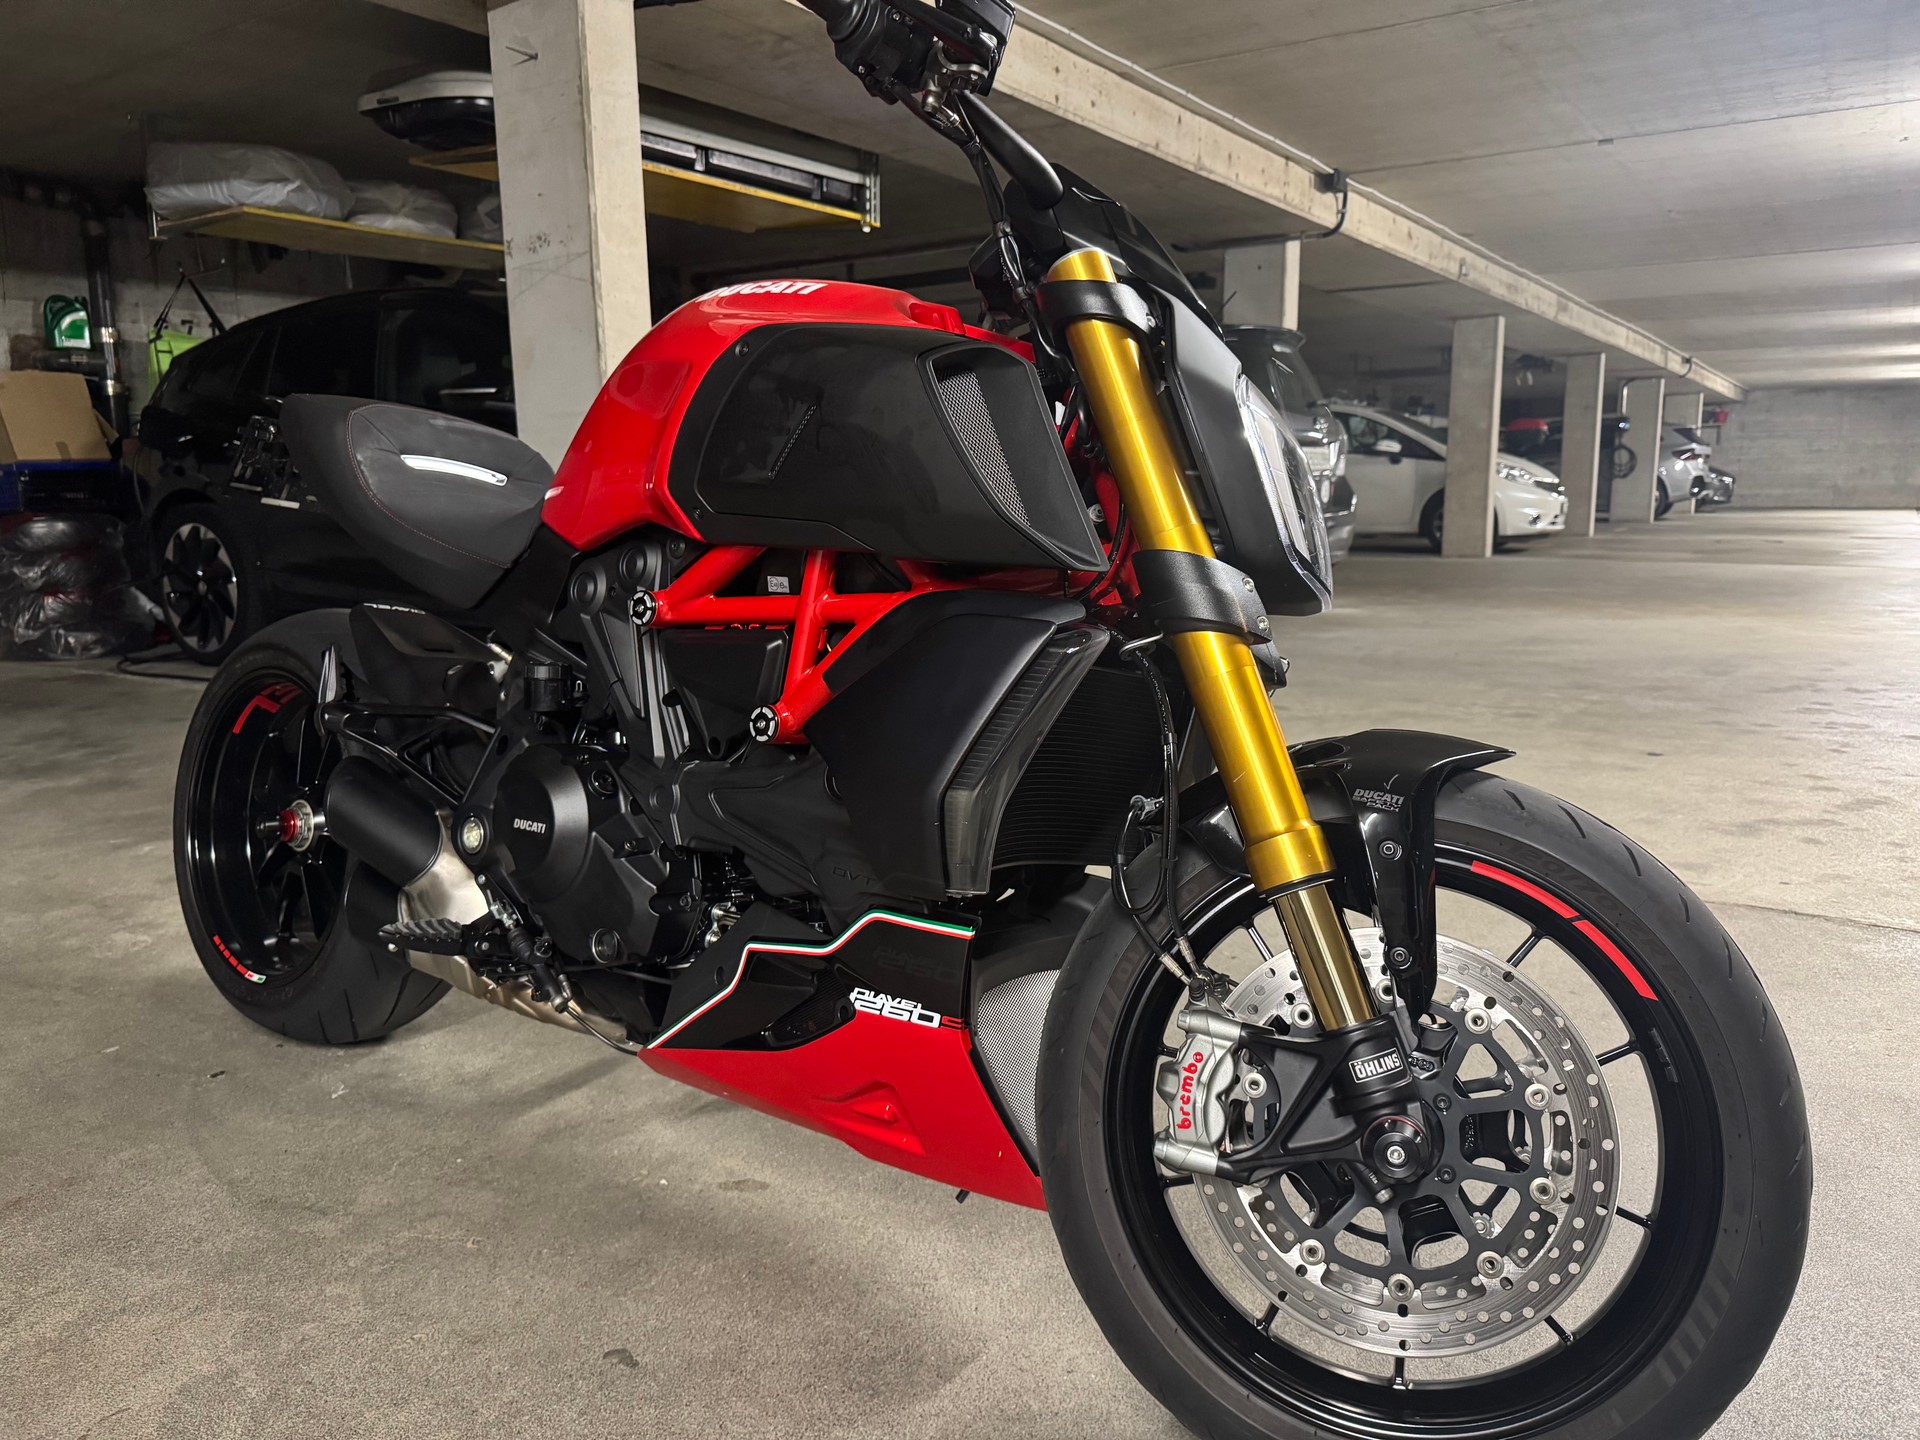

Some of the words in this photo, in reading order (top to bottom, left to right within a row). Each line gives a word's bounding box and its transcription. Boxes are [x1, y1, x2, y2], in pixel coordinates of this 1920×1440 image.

[695, 281, 829, 303] DUCATI
[1353, 788, 1405, 805] DUCATI
[513, 818, 547, 834] DUCATI
[853, 987, 923, 1010] DIAVEL
[1354, 1053, 1401, 1078] ÖHLINS
[1175, 1051, 1204, 1130] brembo
